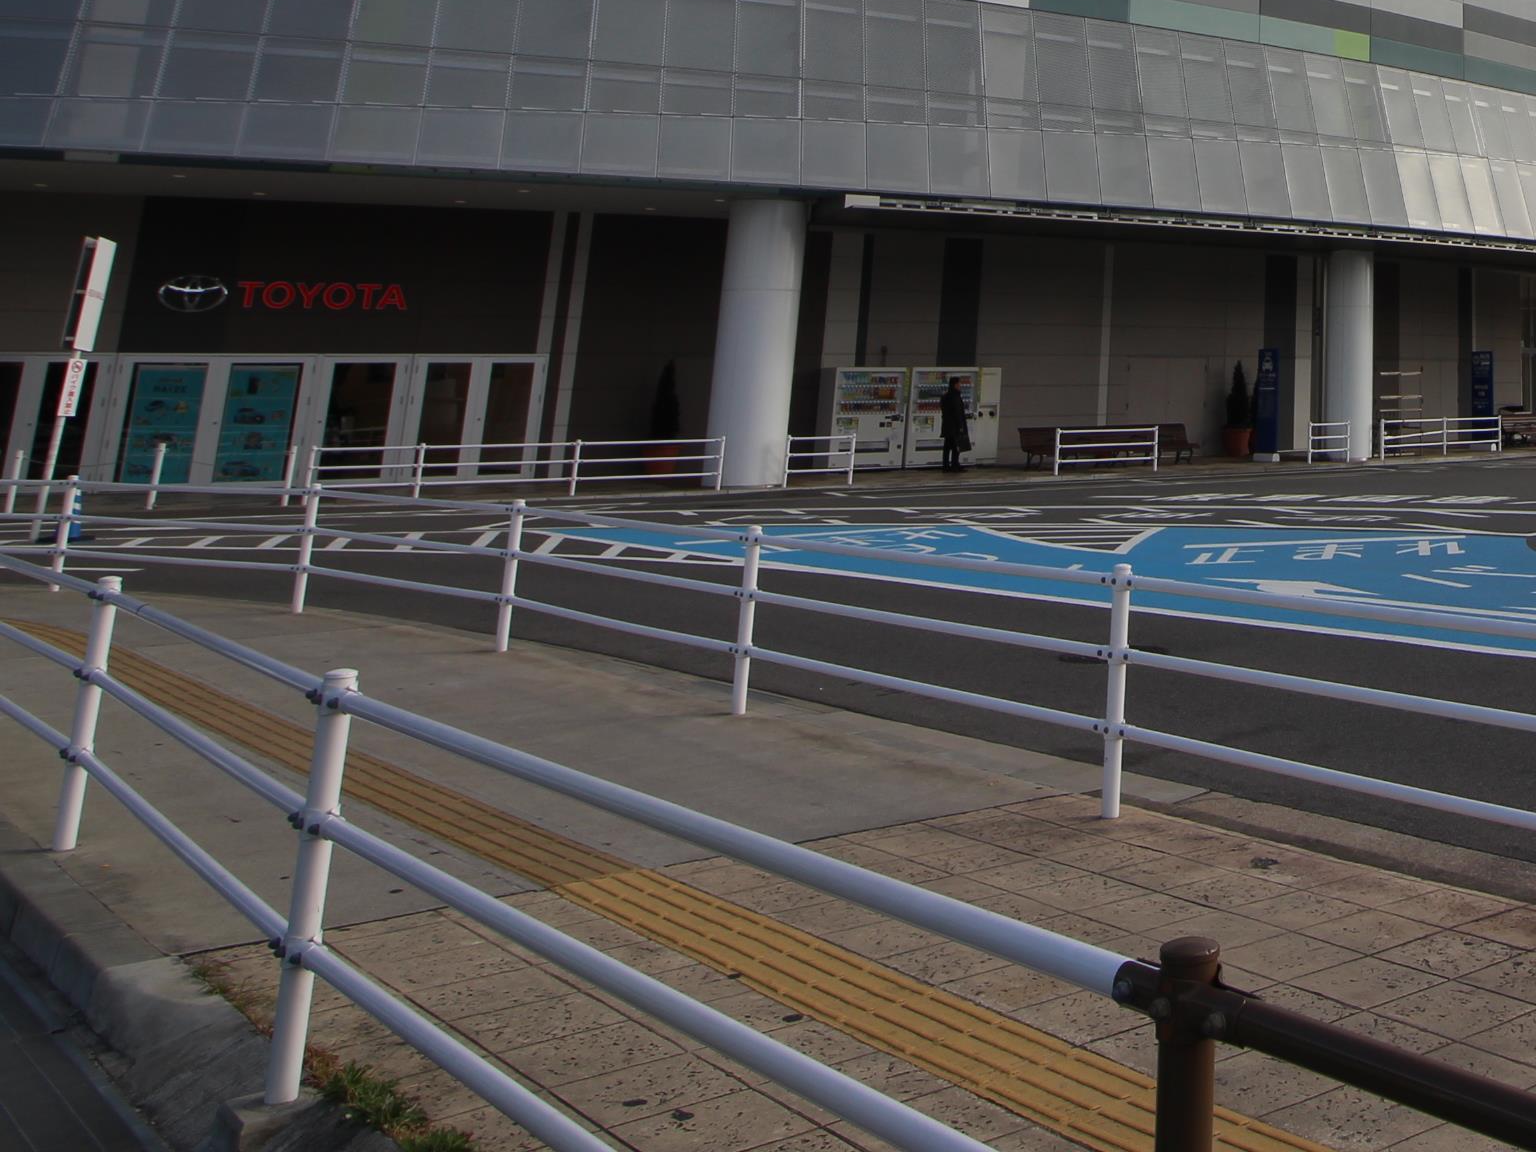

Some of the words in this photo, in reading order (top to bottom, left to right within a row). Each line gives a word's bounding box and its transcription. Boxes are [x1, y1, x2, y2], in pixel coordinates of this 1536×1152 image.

[238, 281, 407, 310] TOYOTA
[1185, 540, 1466, 565] 止まれ
